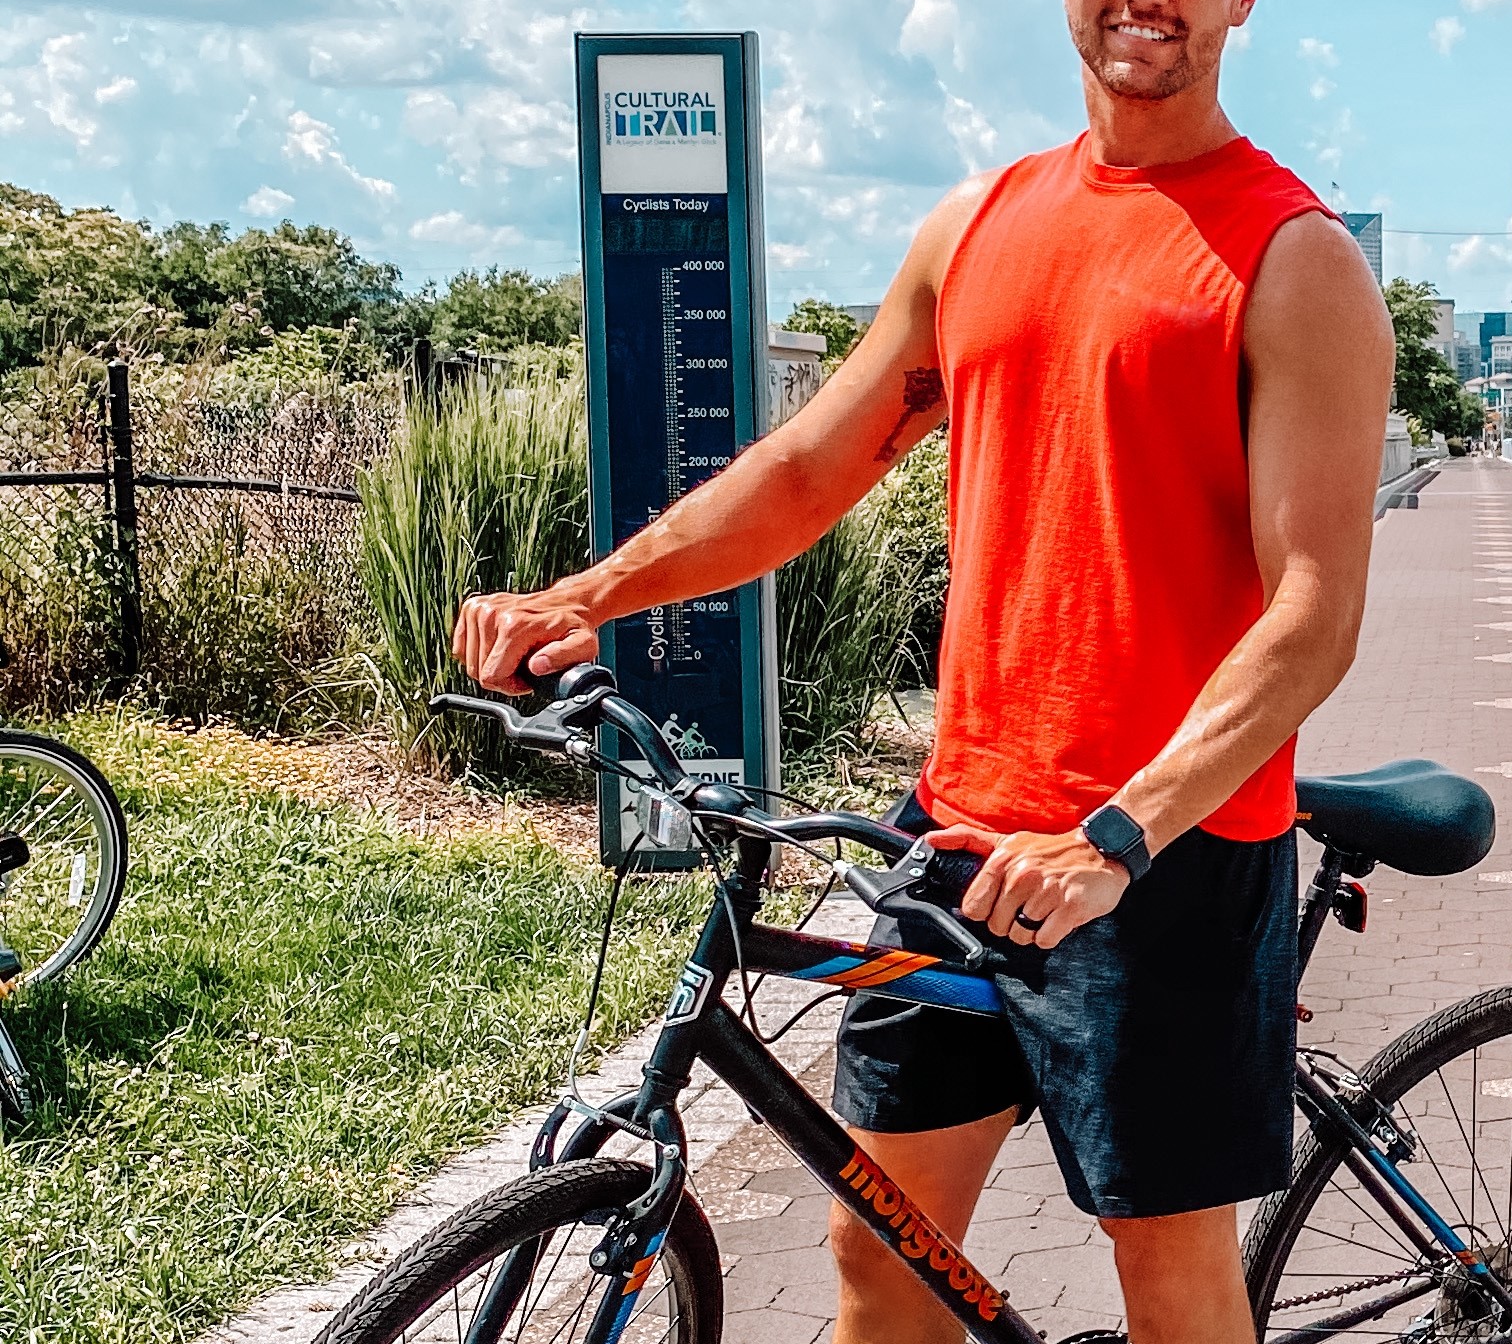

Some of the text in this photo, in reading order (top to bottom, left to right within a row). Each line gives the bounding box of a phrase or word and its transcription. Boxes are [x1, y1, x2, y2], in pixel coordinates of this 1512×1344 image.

[614, 92, 716, 108] CULTURAL
[615, 110, 717, 137] TRAIL
[623, 199, 709, 213] Cyclists Today
[682, 261, 725, 271] 400 000
[684, 310, 726, 320] 350 000
[685, 359, 728, 369] 300 000
[687, 408, 729, 418] 250 000
[688, 457, 731, 467] 200 000
[693, 602, 728, 612] 50 000
[647, 607, 668, 660] Cyclis
[694, 651, 702, 660] 0
[838, 1147, 1003, 1322] mongoose
